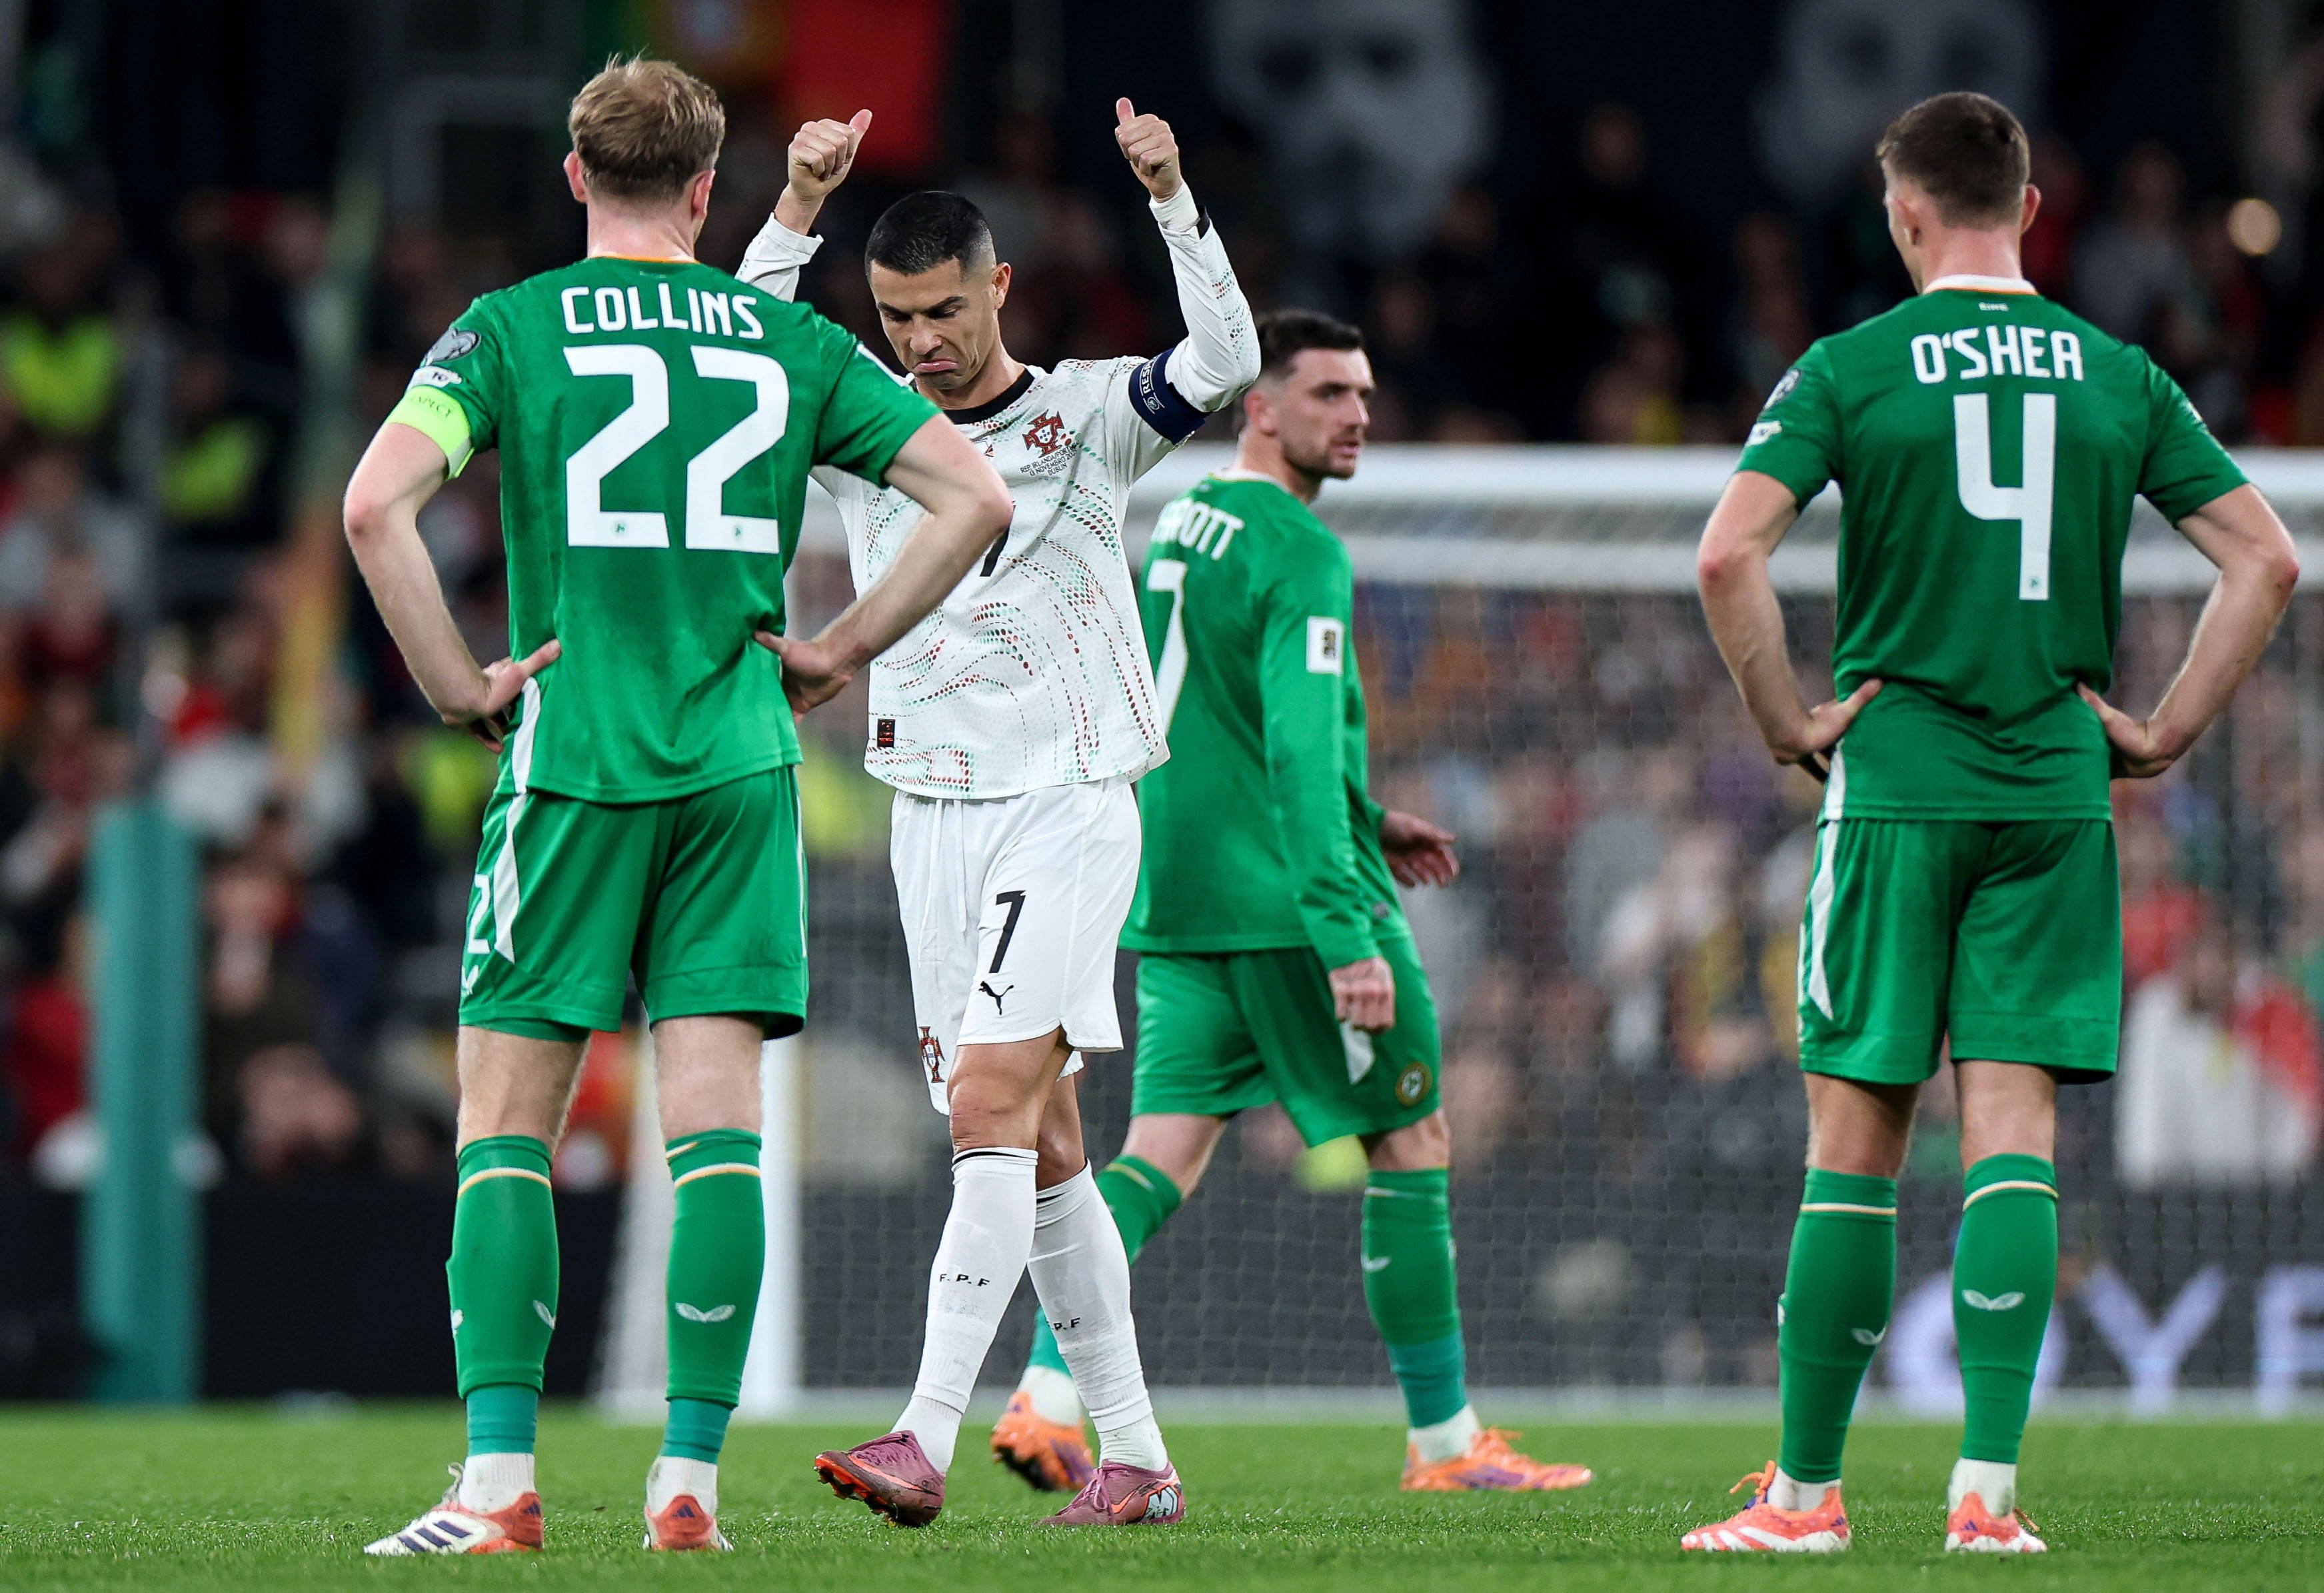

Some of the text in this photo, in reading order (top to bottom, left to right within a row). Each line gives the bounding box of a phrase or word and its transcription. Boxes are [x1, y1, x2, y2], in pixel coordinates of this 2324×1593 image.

[561, 283, 764, 340] COLLINS
[1910, 325, 2084, 384] O'SHEA
[563, 344, 790, 554] 22
[1035, 456, 1066, 474] NOVEMBRO
[1048, 463, 1068, 475] DUBLIN
[1953, 393, 2056, 600] 4
[988, 890, 1026, 974] 7
